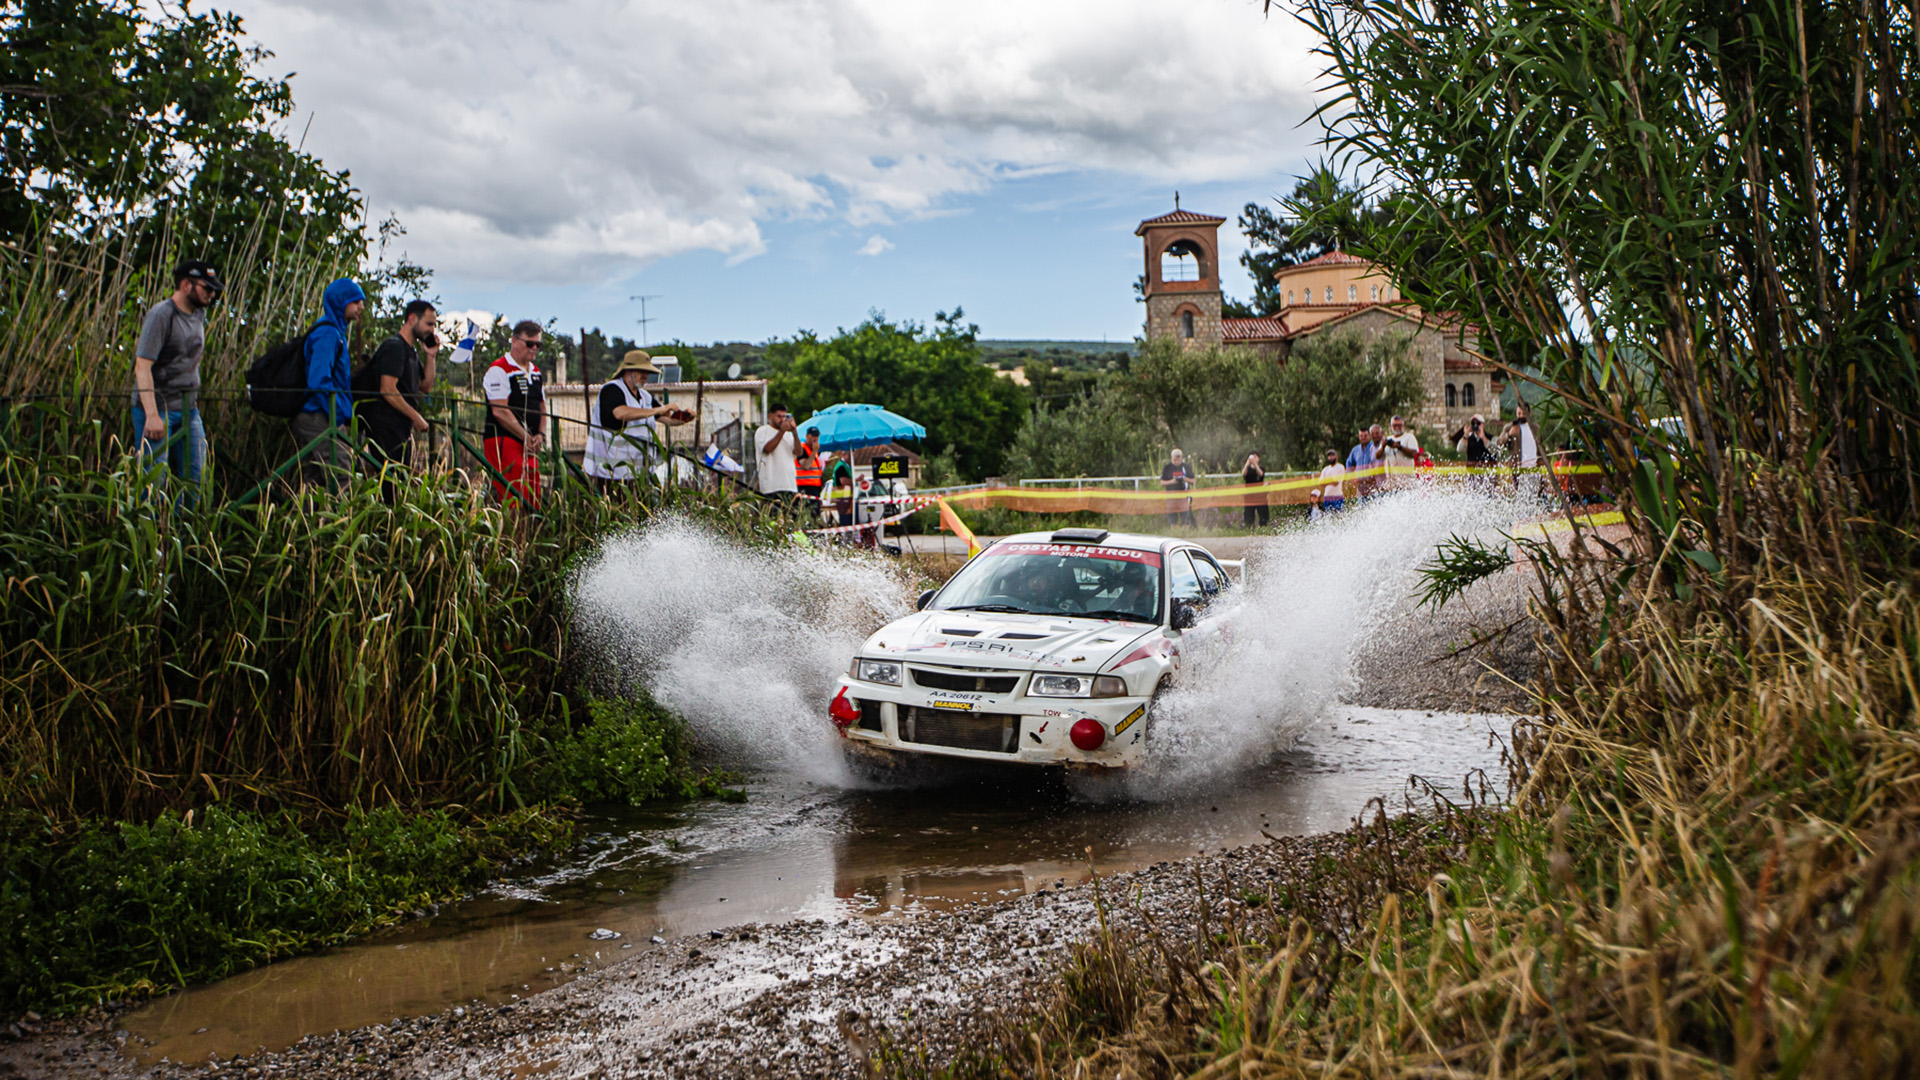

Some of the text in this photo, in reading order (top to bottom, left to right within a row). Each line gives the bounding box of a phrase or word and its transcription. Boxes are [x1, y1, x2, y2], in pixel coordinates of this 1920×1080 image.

[878, 461, 900, 472] ALGE
[1008, 544, 1143, 559] COSTAS PETROU
[934, 700, 972, 710] MANNOL
[1042, 709, 1062, 717] TOW
[1115, 706, 1145, 734] MANNOL
